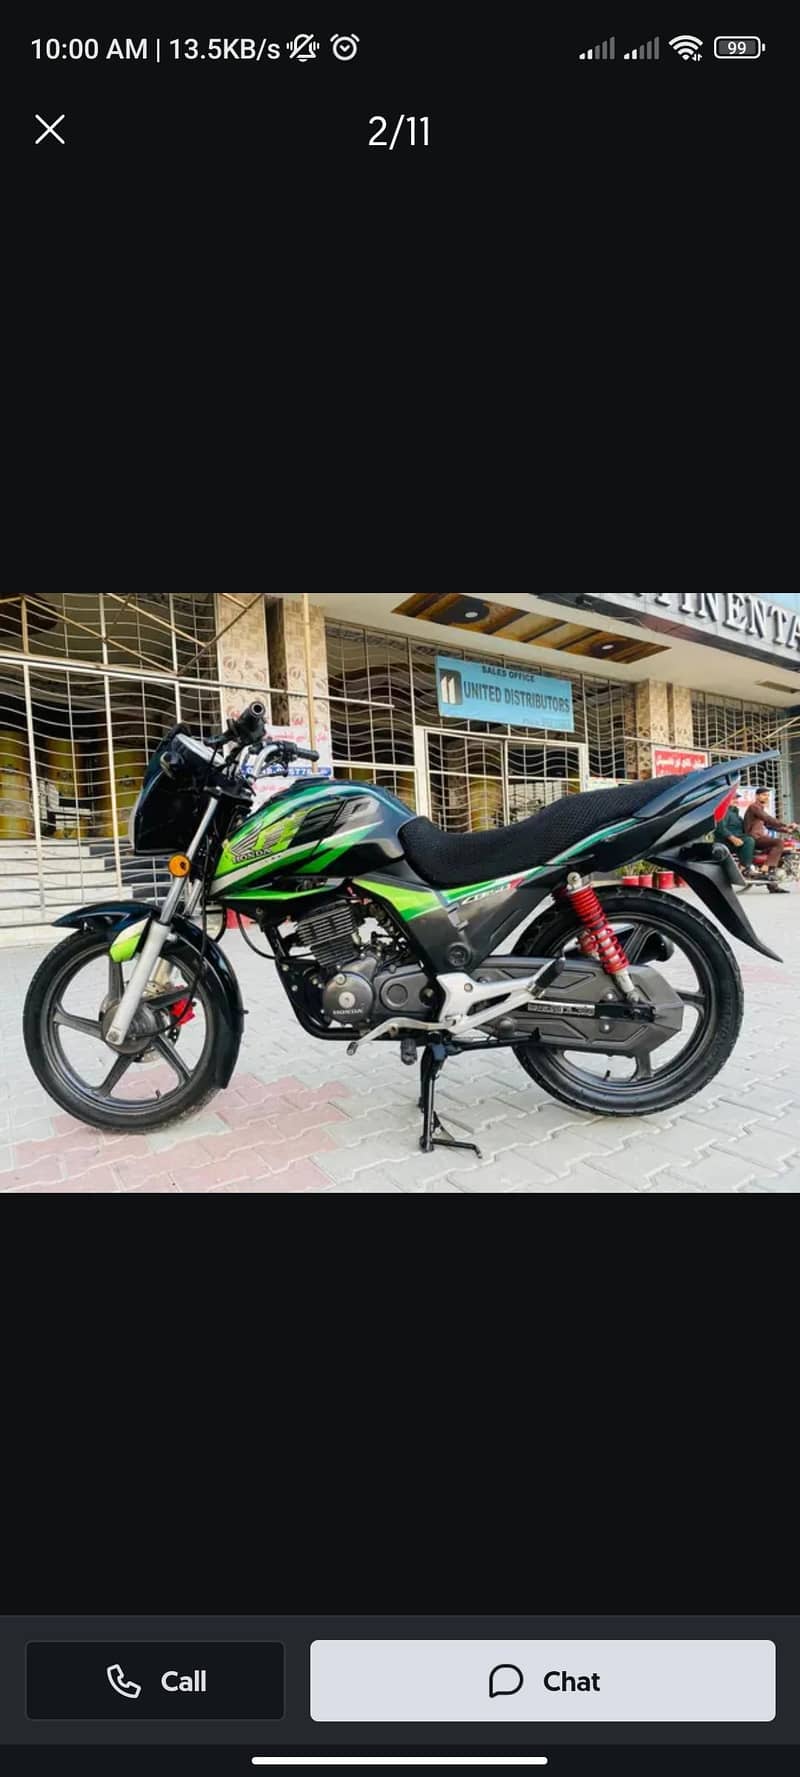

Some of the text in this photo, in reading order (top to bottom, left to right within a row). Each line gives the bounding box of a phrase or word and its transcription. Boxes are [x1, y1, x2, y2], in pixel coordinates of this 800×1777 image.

[482, 666, 535, 683] SALES OFFICE
[464, 681, 569, 712] UNITED DISTRIBUTORS
[234, 849, 272, 864] HONDA
